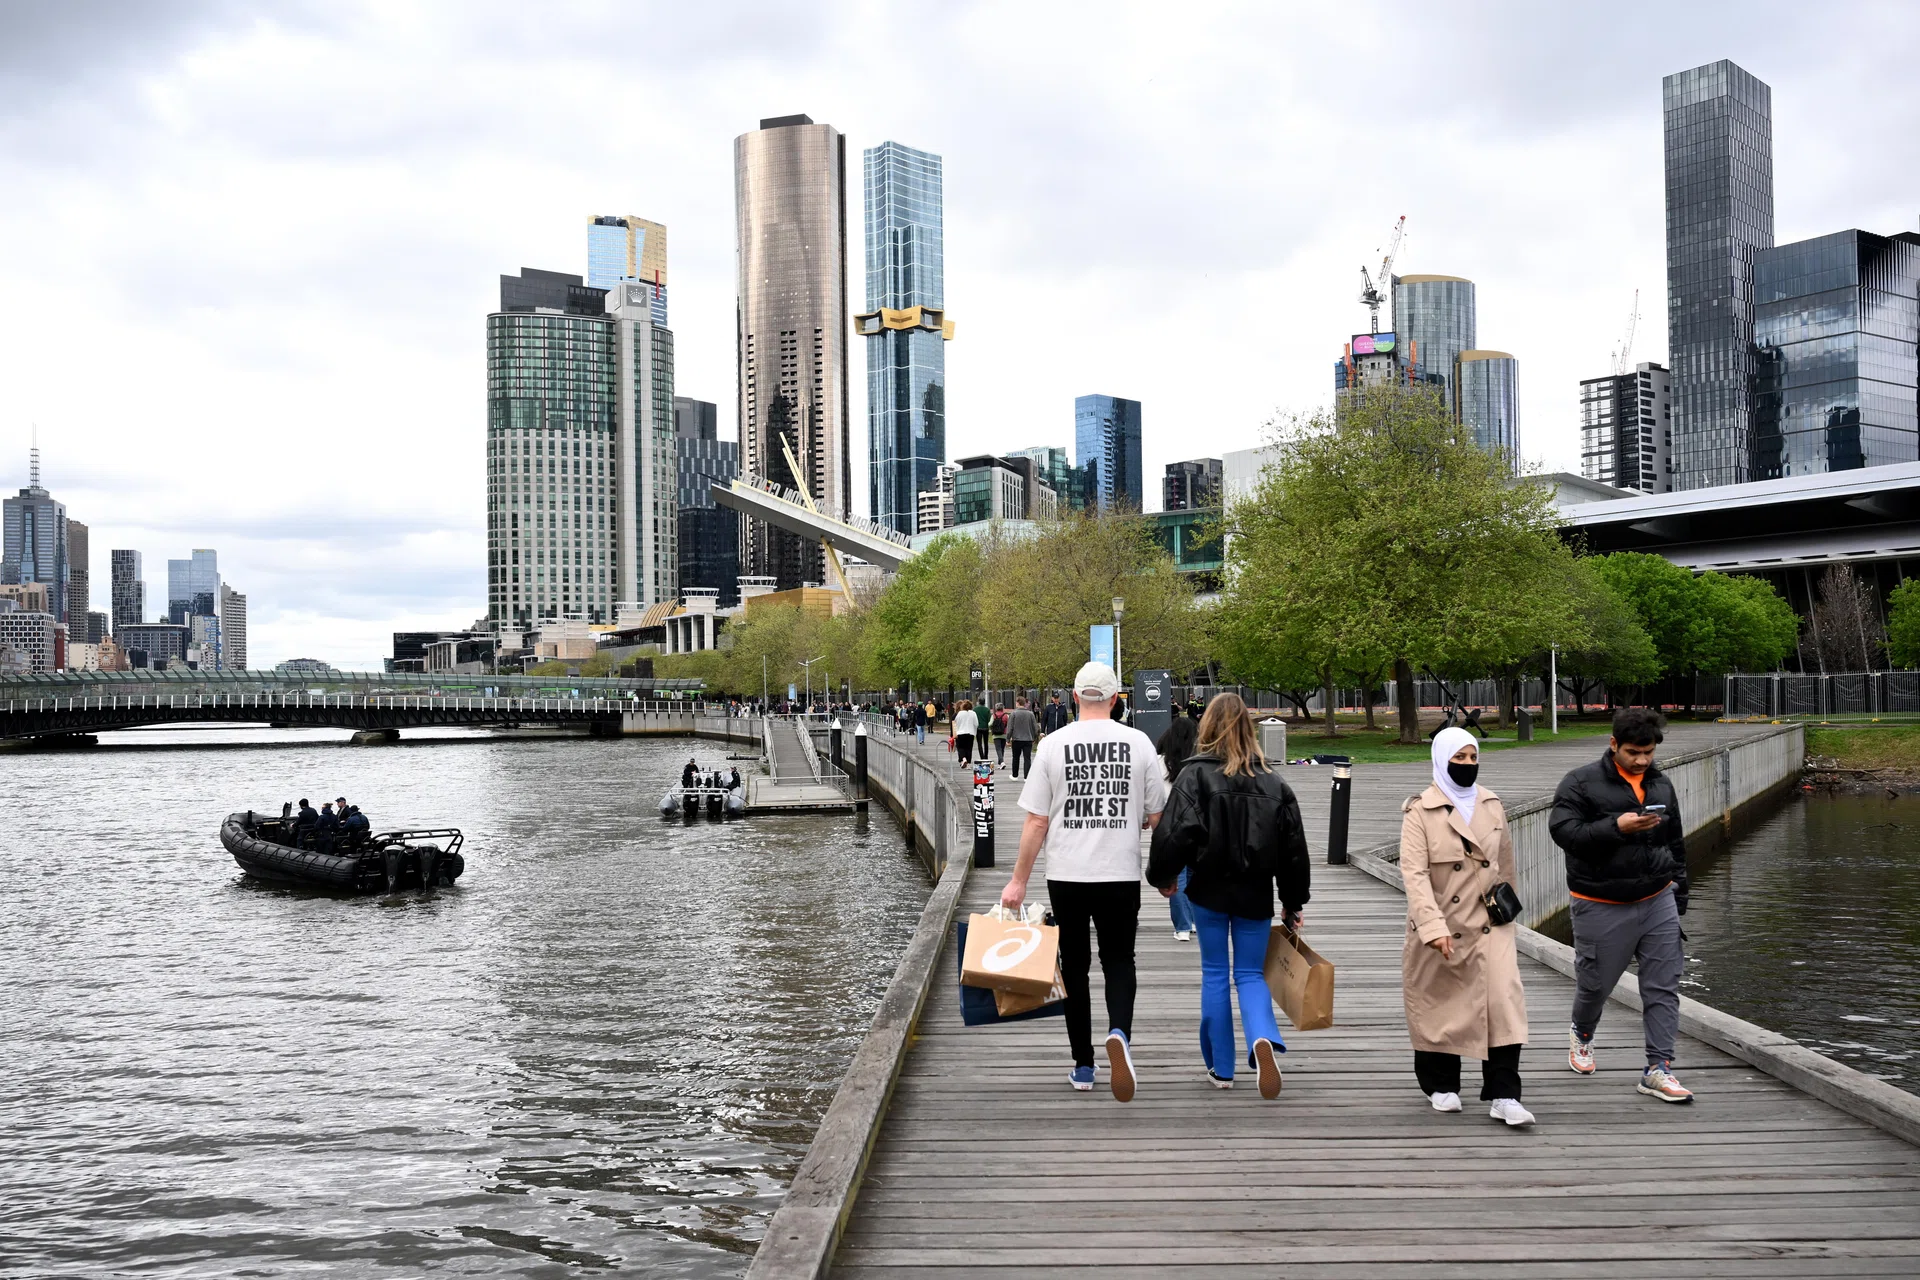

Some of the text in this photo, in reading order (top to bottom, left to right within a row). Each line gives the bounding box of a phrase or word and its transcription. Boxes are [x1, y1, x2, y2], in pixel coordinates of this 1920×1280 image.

[1064, 742, 1131, 764] LOWER
[1065, 764, 1131, 781] EAST SIDE
[1067, 780, 1129, 797] JAZZ CLUB
[1063, 797, 1128, 818] PIKE ST
[1063, 819, 1127, 829] NEW YORK CITY
